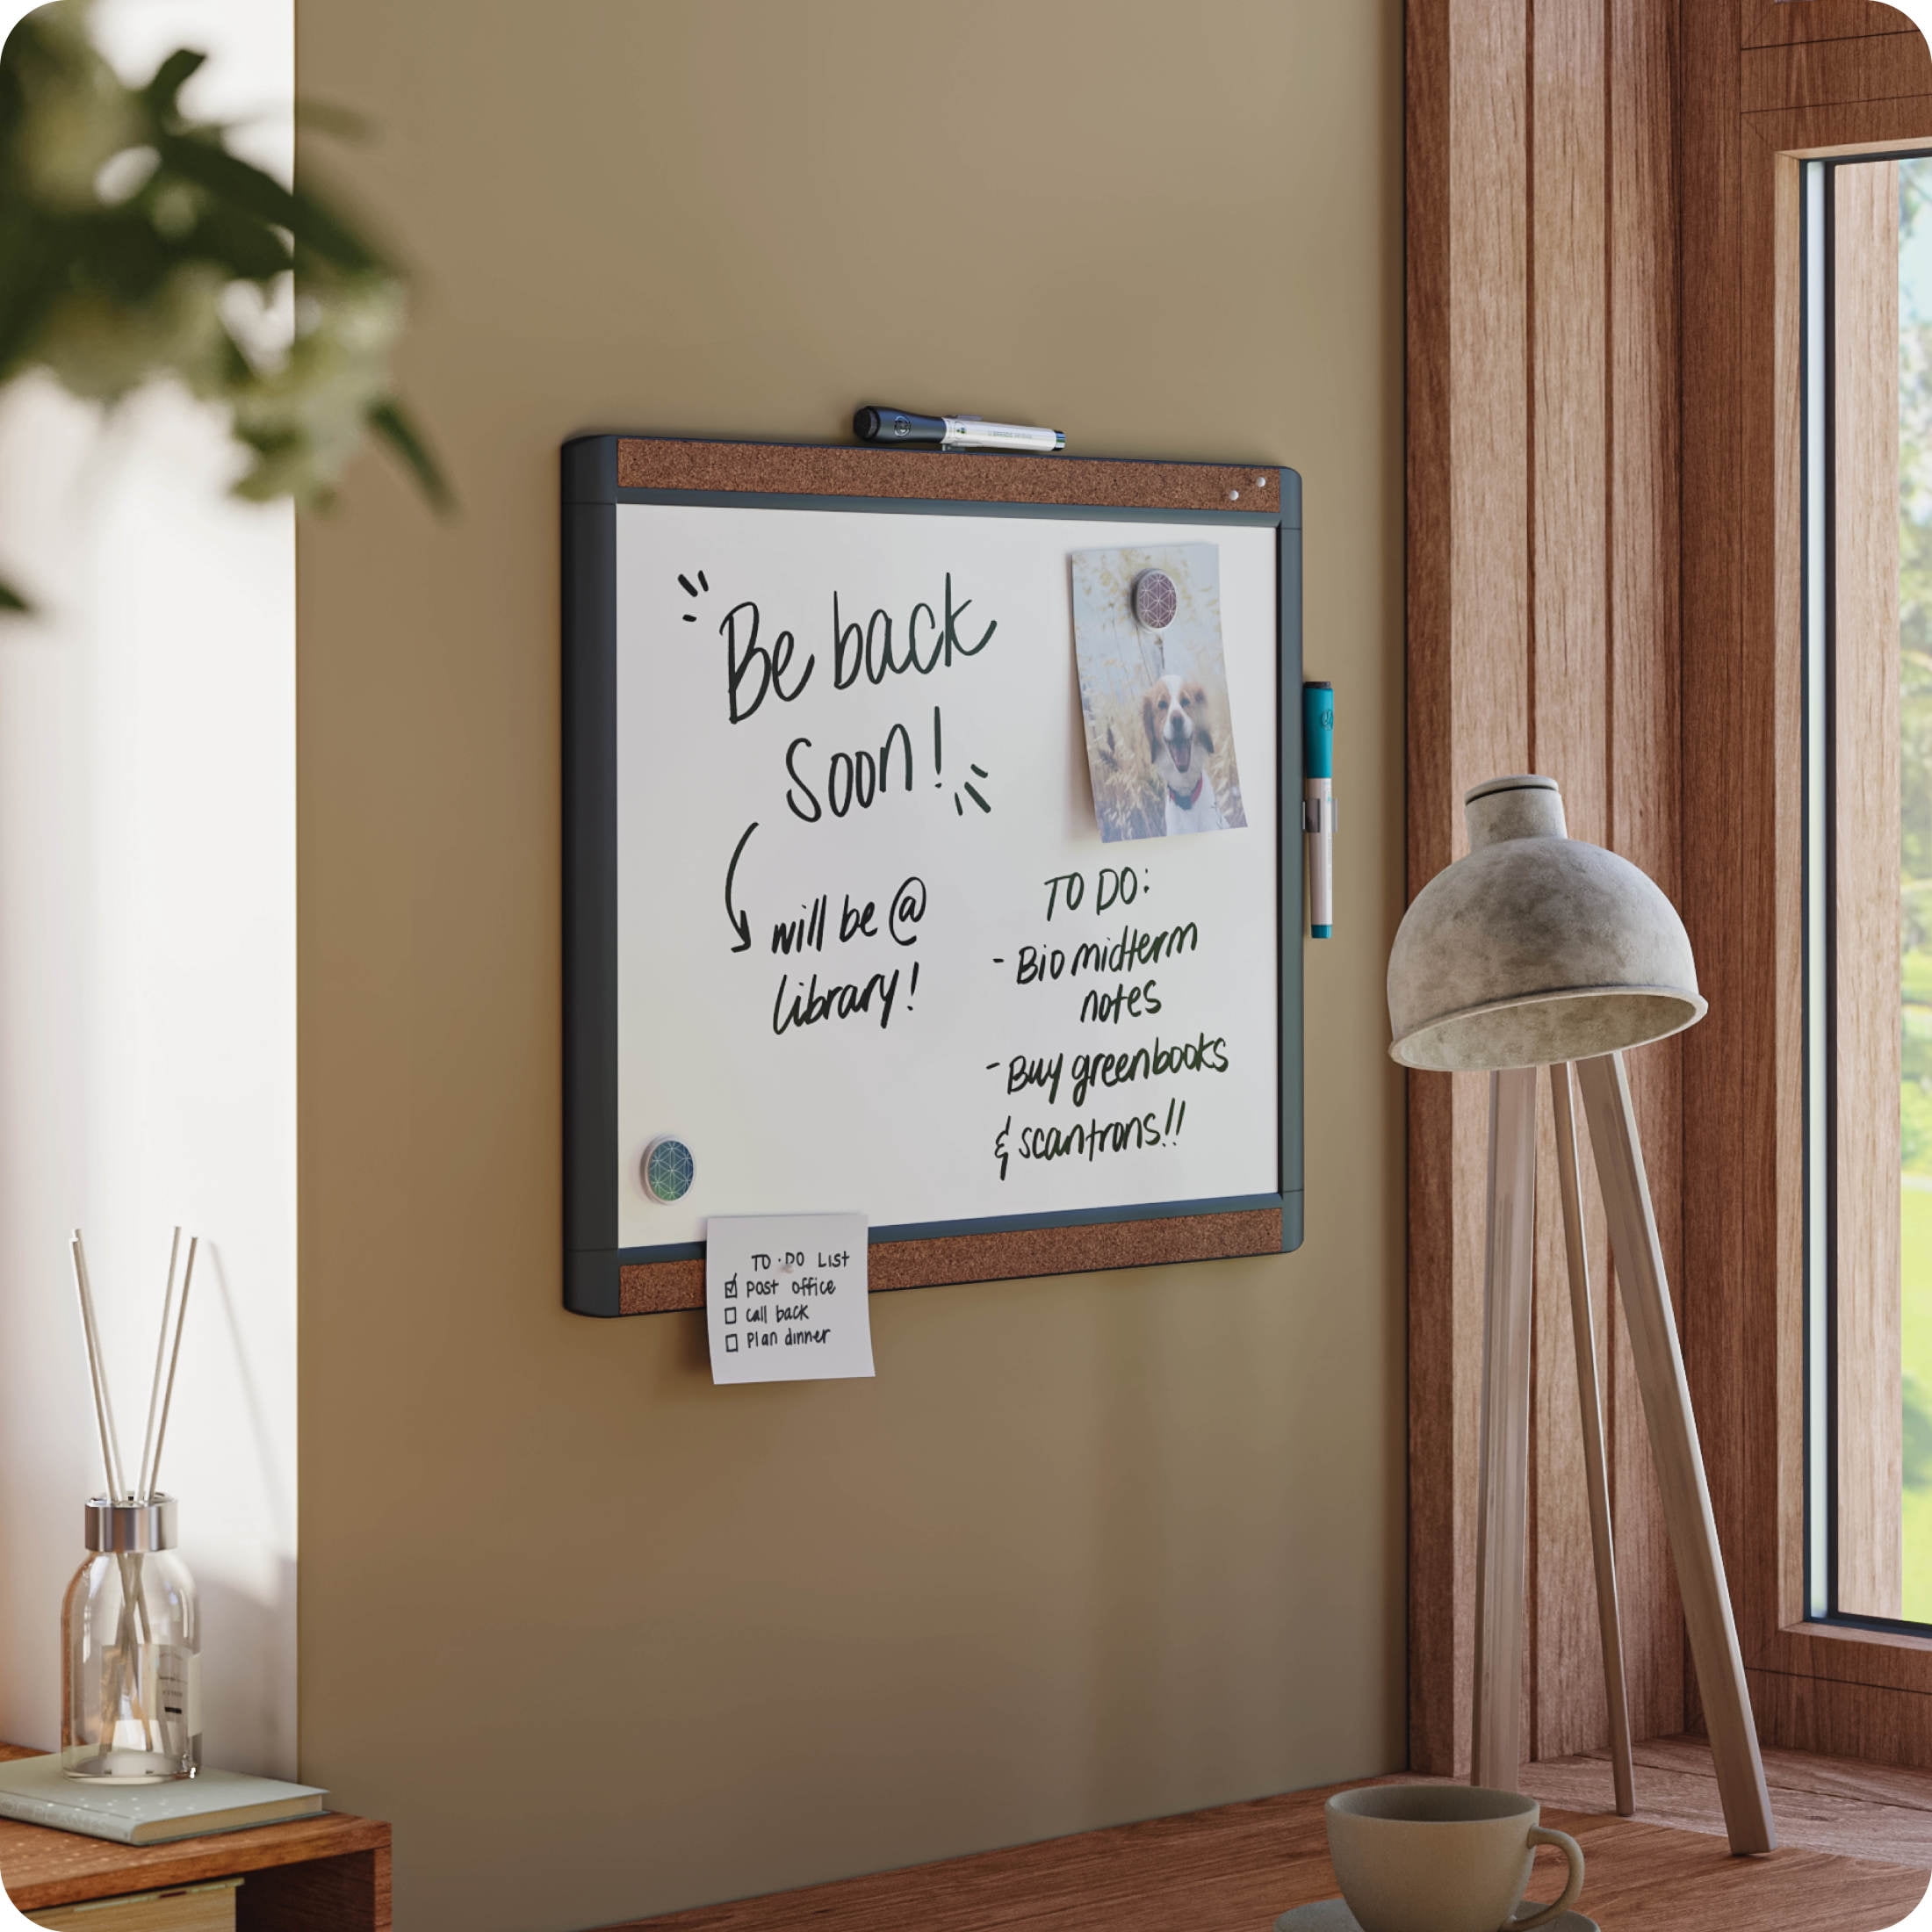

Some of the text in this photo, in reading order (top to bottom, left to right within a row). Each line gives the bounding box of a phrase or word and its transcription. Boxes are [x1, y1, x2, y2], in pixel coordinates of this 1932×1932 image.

[719, 573, 997, 724] Be back
[771, 876, 926, 955] will be @
[1044, 867, 1150, 921] TO DO:
[1071, 922, 1197, 976] midterm
[1080, 980, 1161, 1024] notes
[1071, 1033, 1229, 1107] greenbooks
[1019, 1097, 1186, 1162] scantrons!!
[776, 1304, 809, 1323] back
[792, 1277, 836, 1296] office
[785, 1328, 831, 1345] dinner
